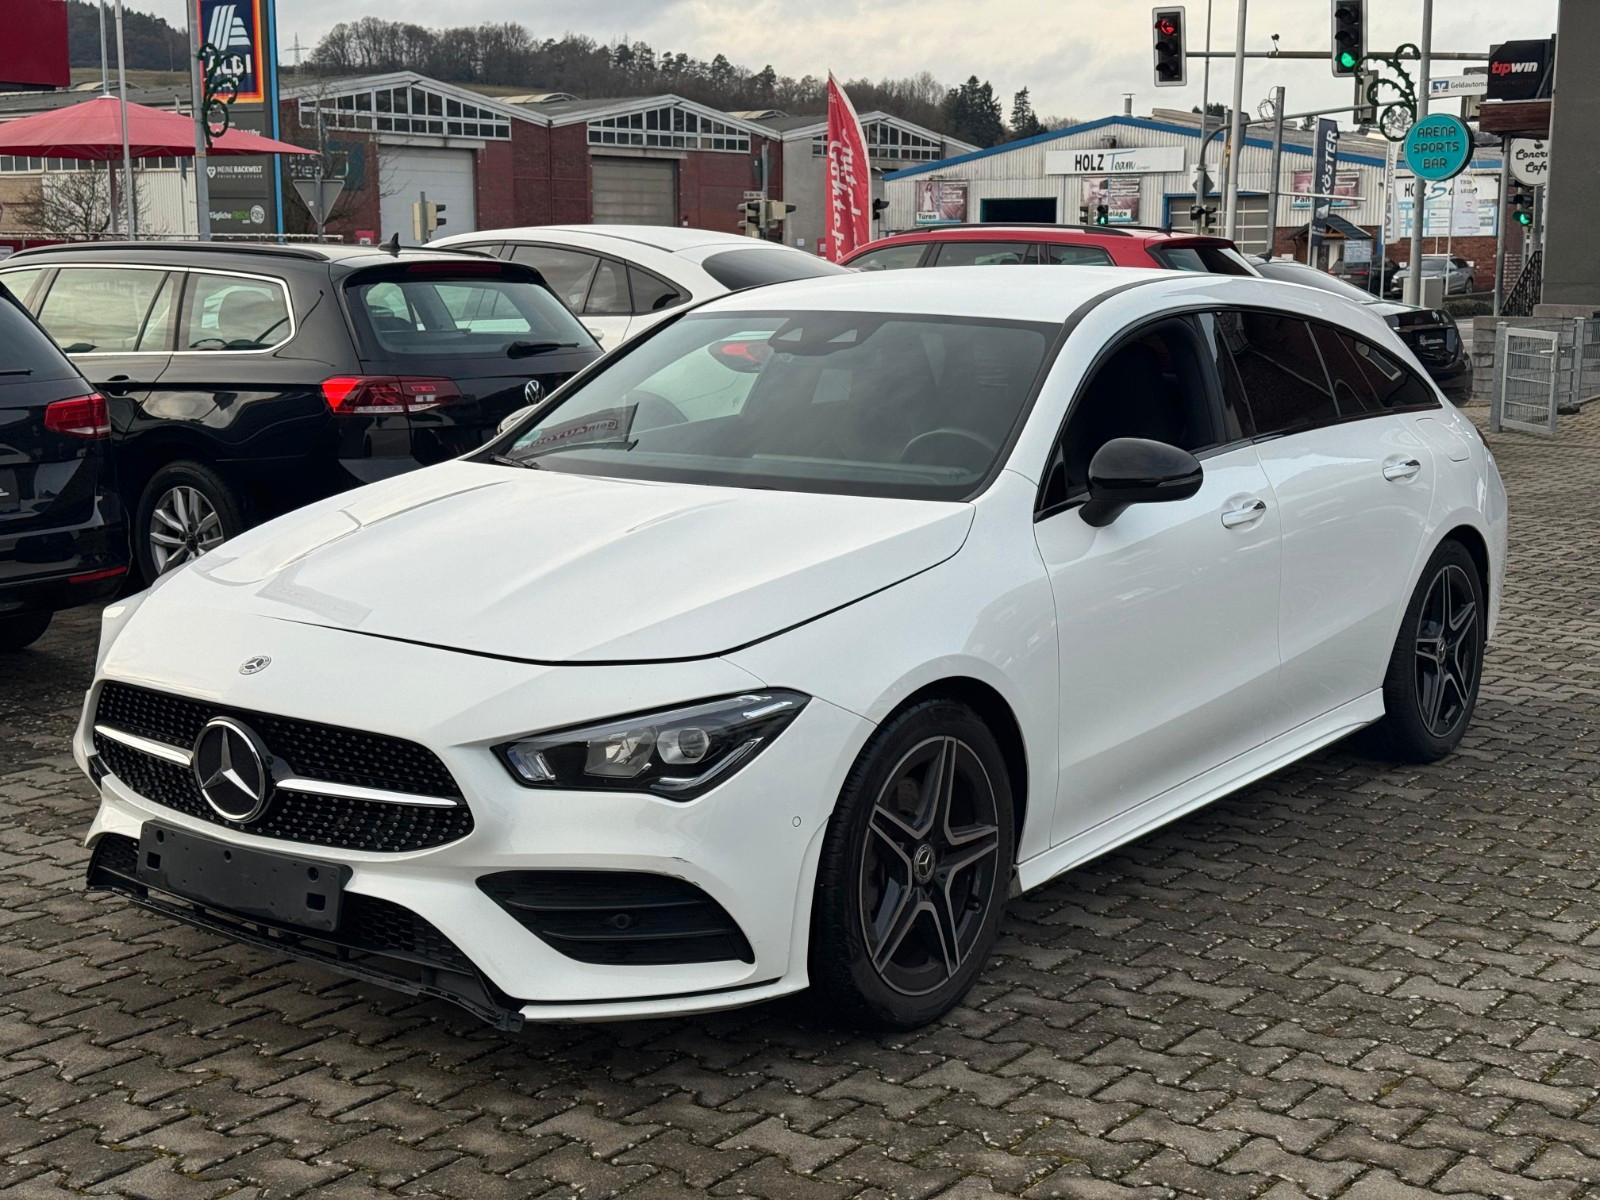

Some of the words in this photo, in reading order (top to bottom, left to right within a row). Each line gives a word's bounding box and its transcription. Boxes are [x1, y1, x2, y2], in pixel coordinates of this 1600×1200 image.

[1491, 61, 1539, 77] tipwin
[1417, 126, 1456, 138] ARENA
[1413, 140, 1460, 154] SPORTS
[1075, 153, 1104, 172] HOLZ
[1106, 150, 1137, 171] Team
[1422, 157, 1448, 169] BAR
